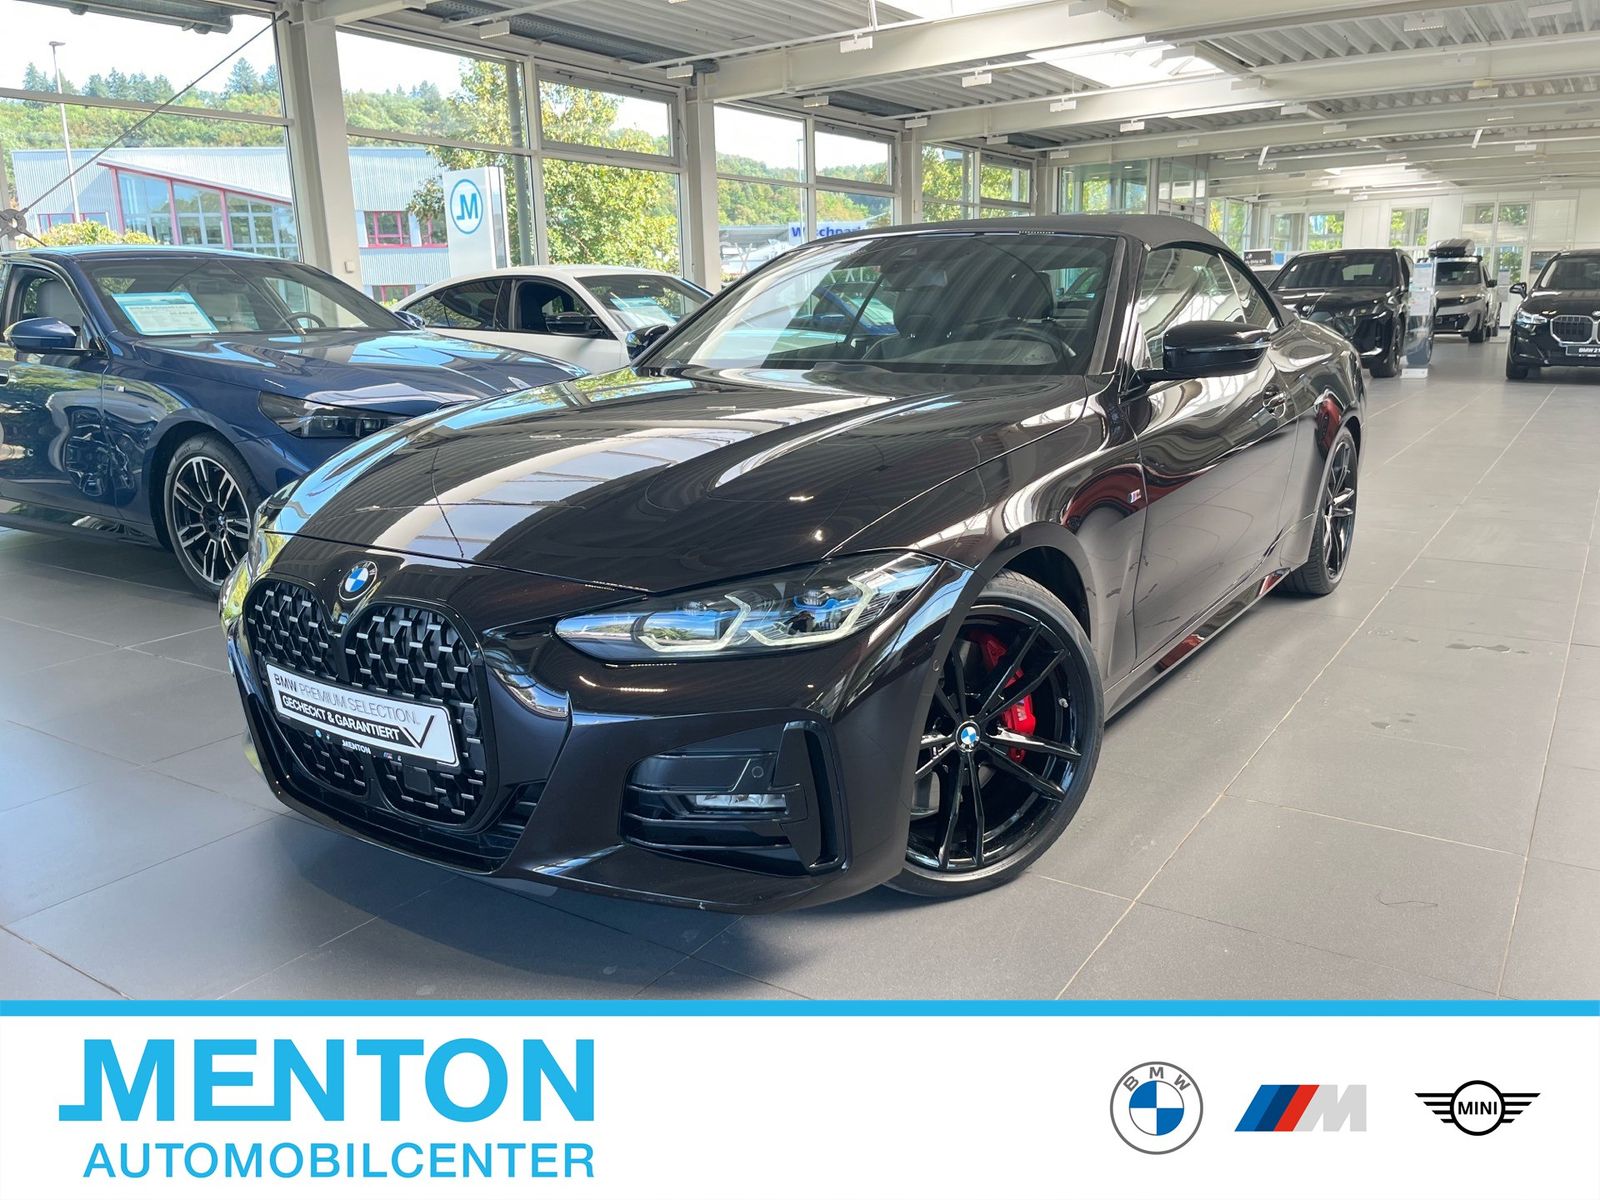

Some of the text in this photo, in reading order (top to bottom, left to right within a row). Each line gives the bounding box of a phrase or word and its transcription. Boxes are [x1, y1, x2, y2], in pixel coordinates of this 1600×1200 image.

[273, 673, 297, 692] BMW
[299, 683, 346, 708] PREMIUM
[282, 695, 327, 720] GECHECKT
[327, 711, 335, 724] &
[335, 713, 400, 741] GARANTIERT
[341, 739, 372, 755] MENTON
